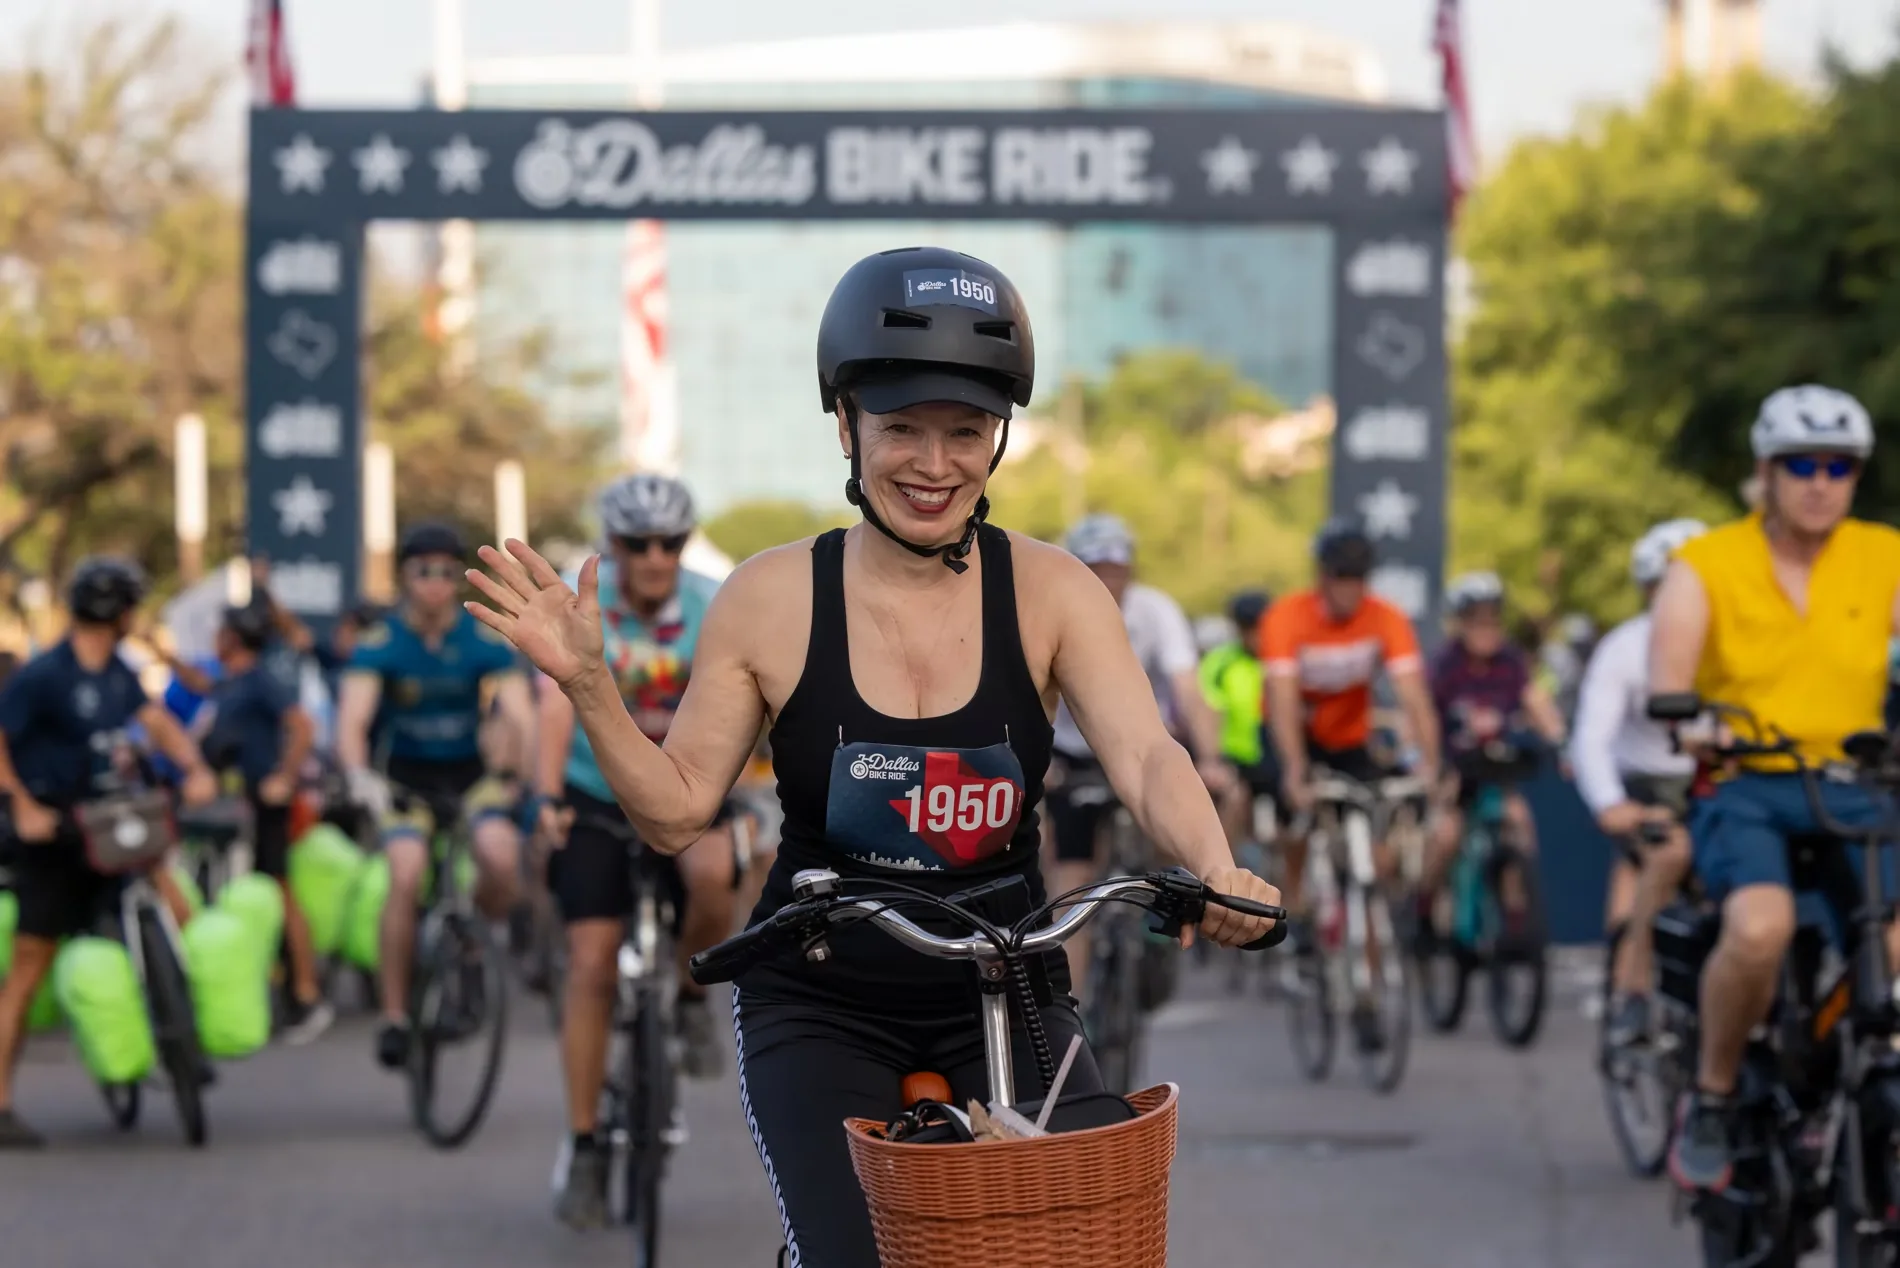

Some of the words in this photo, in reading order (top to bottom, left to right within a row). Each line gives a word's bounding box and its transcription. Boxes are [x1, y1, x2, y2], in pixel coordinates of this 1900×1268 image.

[571, 117, 815, 207] Dallas
[828, 127, 986, 204] BIKE
[992, 127, 1154, 205] RIDE
[950, 277, 995, 305] 1950
[868, 753, 920, 772] Dallas
[869, 771, 887, 780] BIKE
[888, 772, 907, 780] RIDE
[905, 781, 1015, 833] 1950
